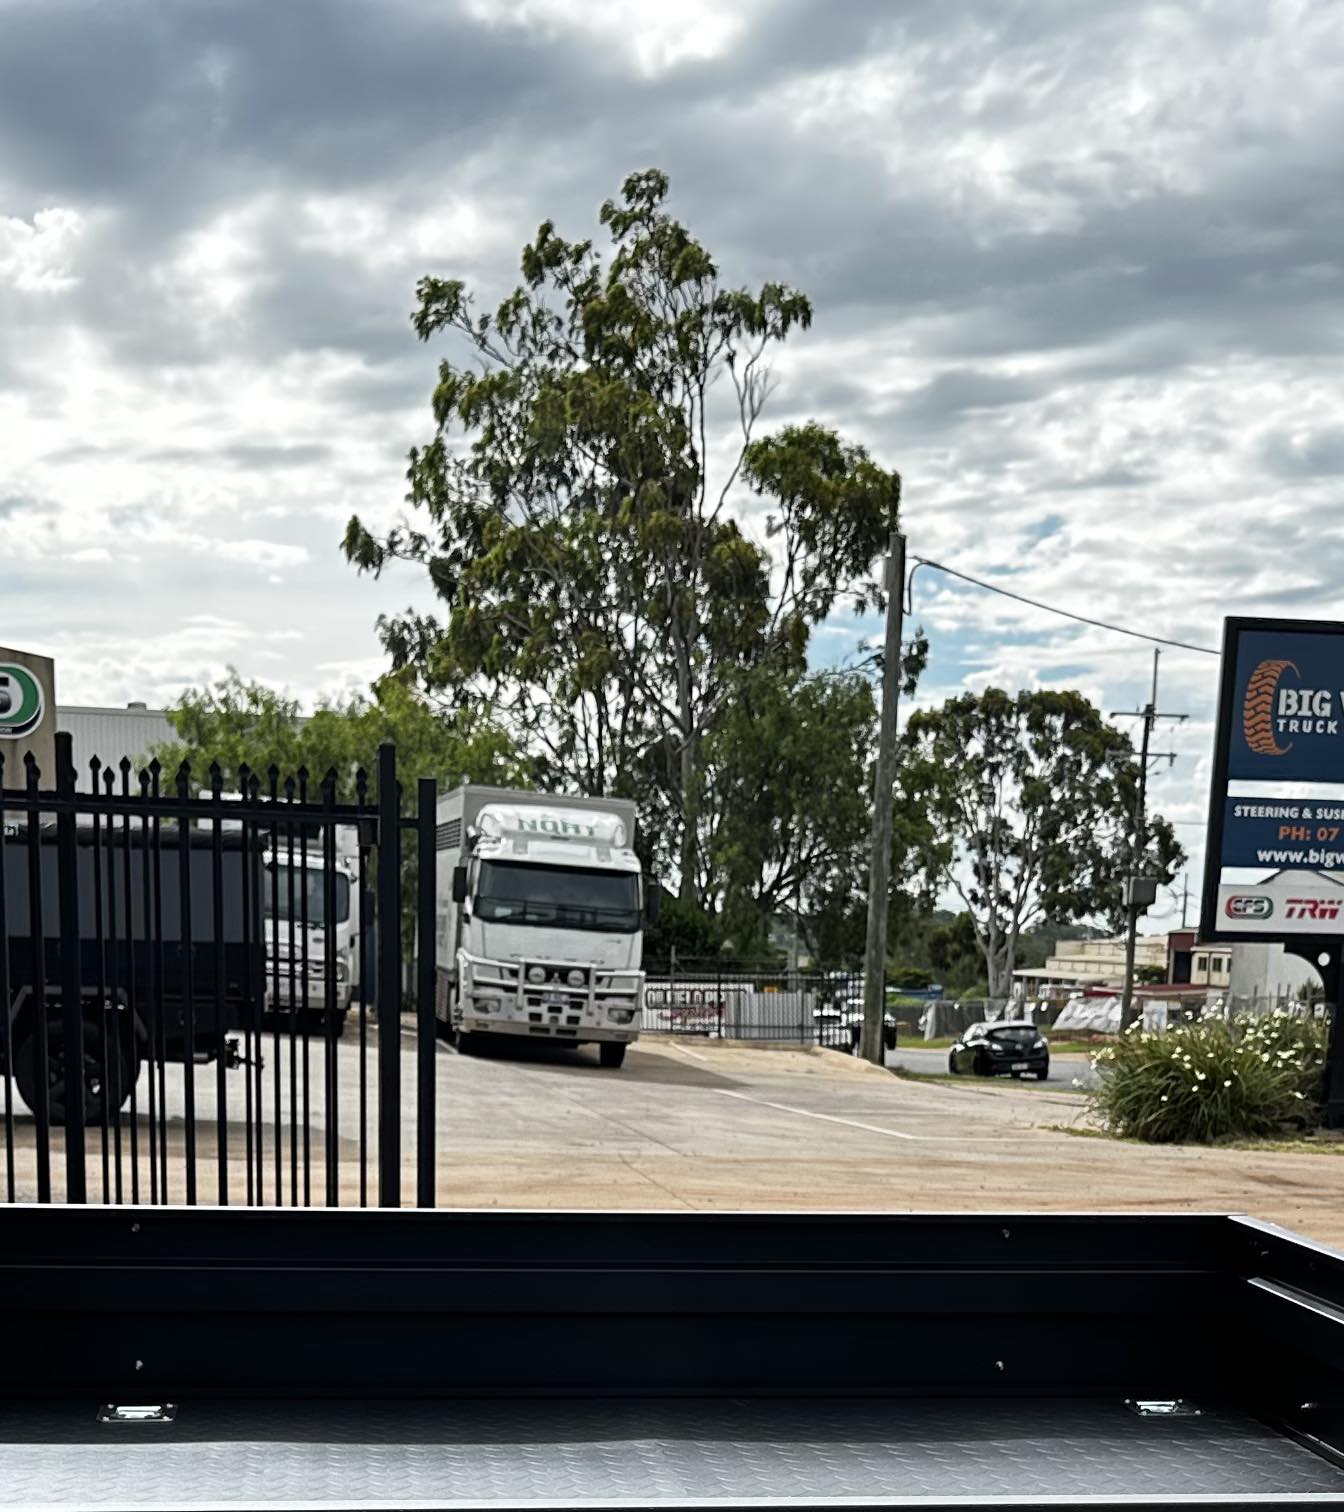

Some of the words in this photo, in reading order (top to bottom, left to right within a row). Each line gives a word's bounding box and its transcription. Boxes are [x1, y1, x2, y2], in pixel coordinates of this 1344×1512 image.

[1277, 688, 1331, 718] BIG
[1277, 720, 1337, 735] TRUCK
[1234, 805, 1299, 819] STEERING
[1302, 808, 1312, 819] &
[1278, 825, 1311, 841] PH:
[1316, 827, 1340, 842] 07
[1284, 899, 1344, 920] TRW
